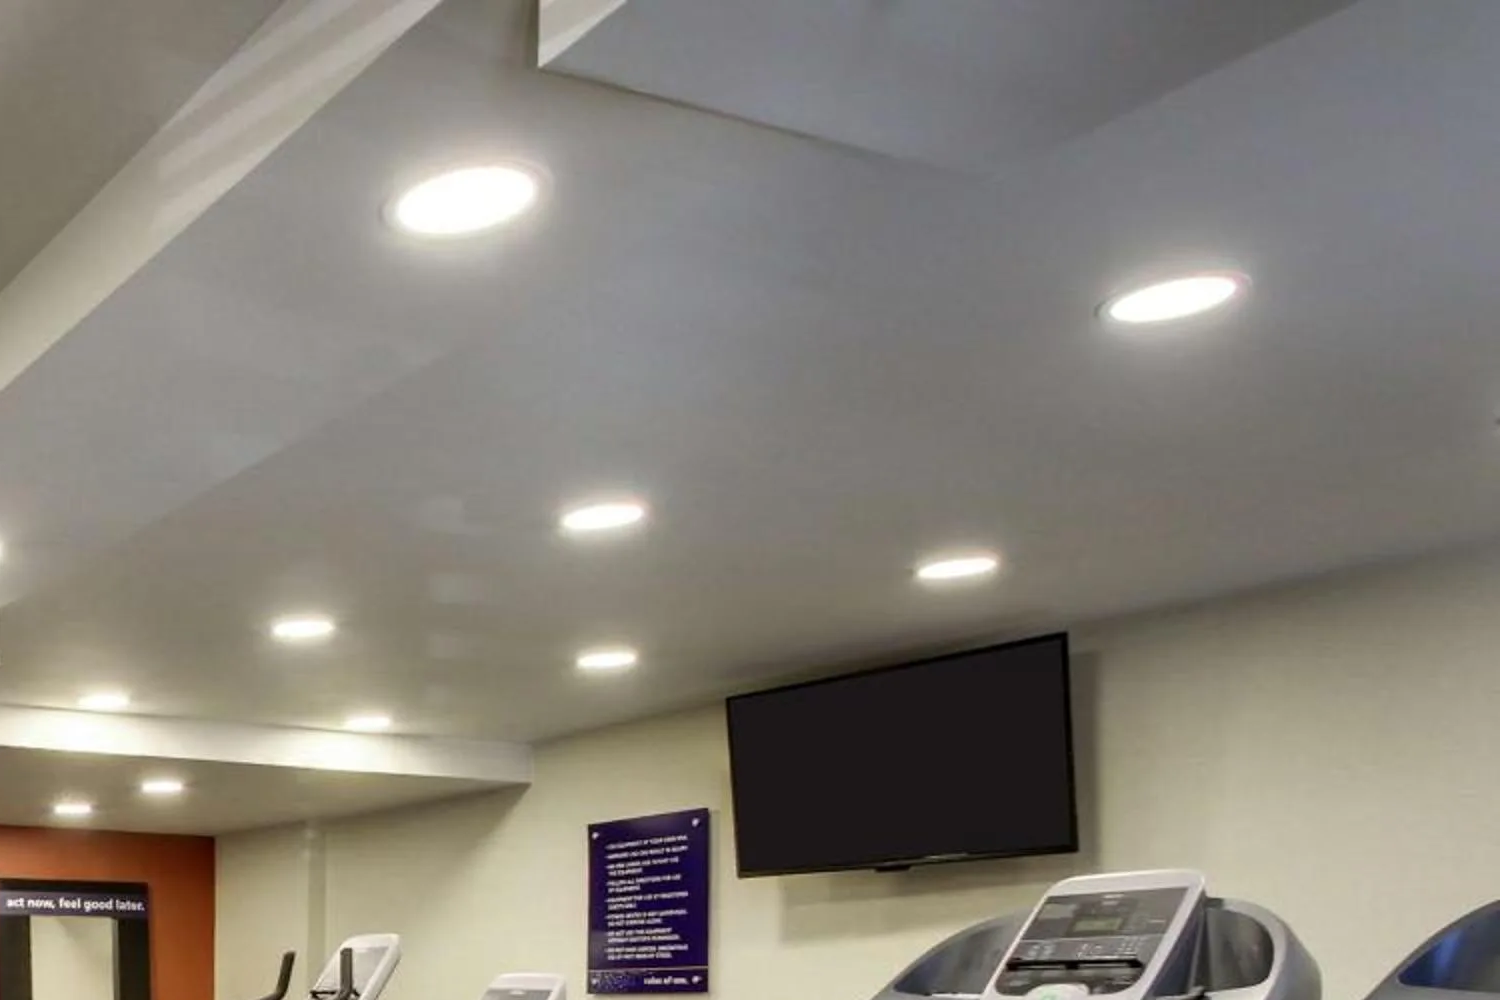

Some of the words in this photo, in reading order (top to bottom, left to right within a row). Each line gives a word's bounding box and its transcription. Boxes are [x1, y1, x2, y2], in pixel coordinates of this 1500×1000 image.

[6, 897, 25, 908] act
[27, 899, 56, 909] now,
[59, 897, 81, 909] feel
[83, 898, 113, 912] good
[115, 899, 145, 911] later.
